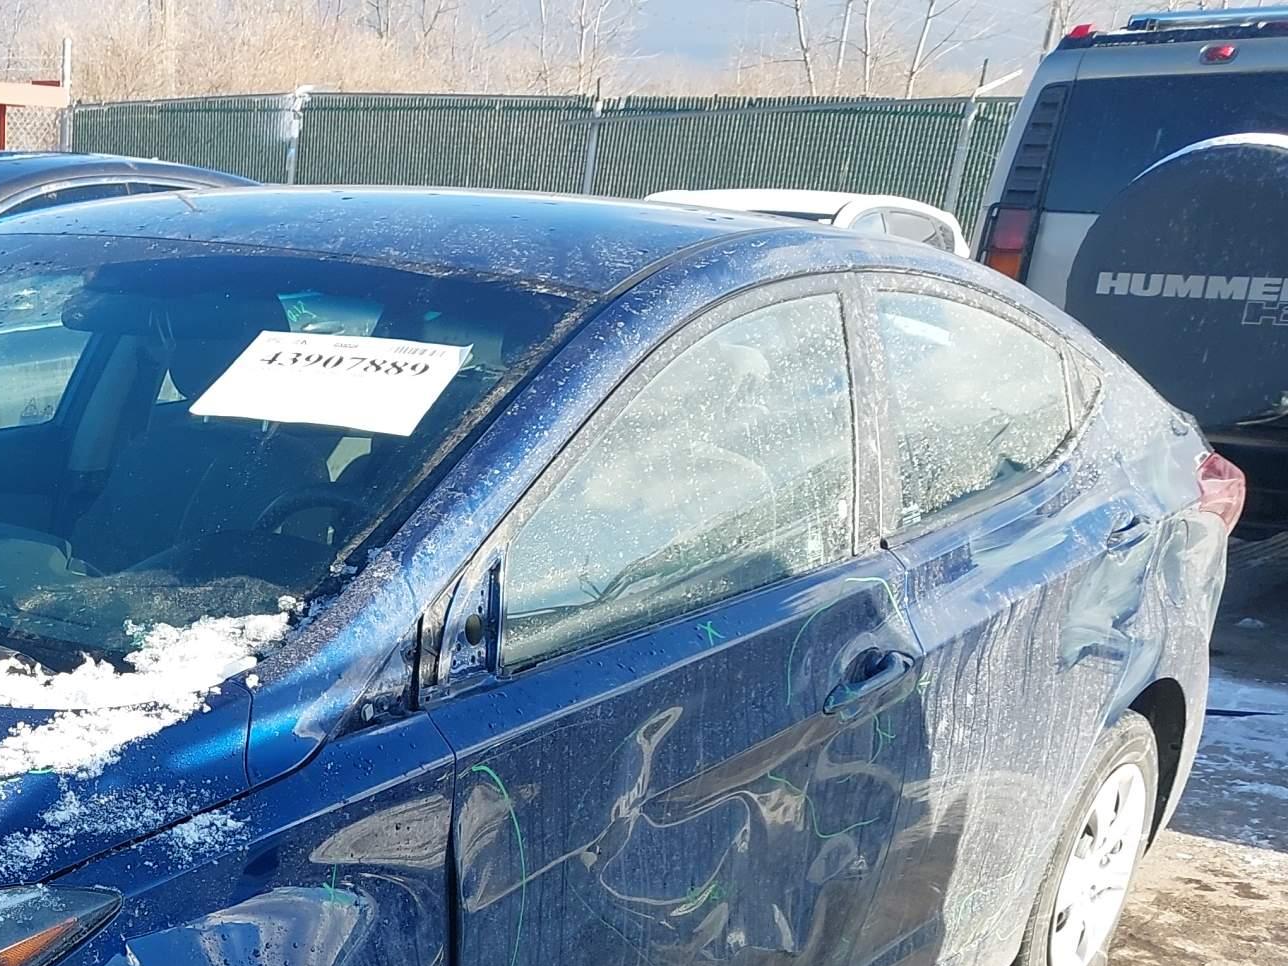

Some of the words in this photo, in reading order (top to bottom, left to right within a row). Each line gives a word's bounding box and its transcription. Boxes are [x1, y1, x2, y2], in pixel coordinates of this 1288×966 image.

[1096, 271, 1288, 301] HUMME
[1241, 301, 1288, 326] H
[260, 351, 430, 376] 43907889
